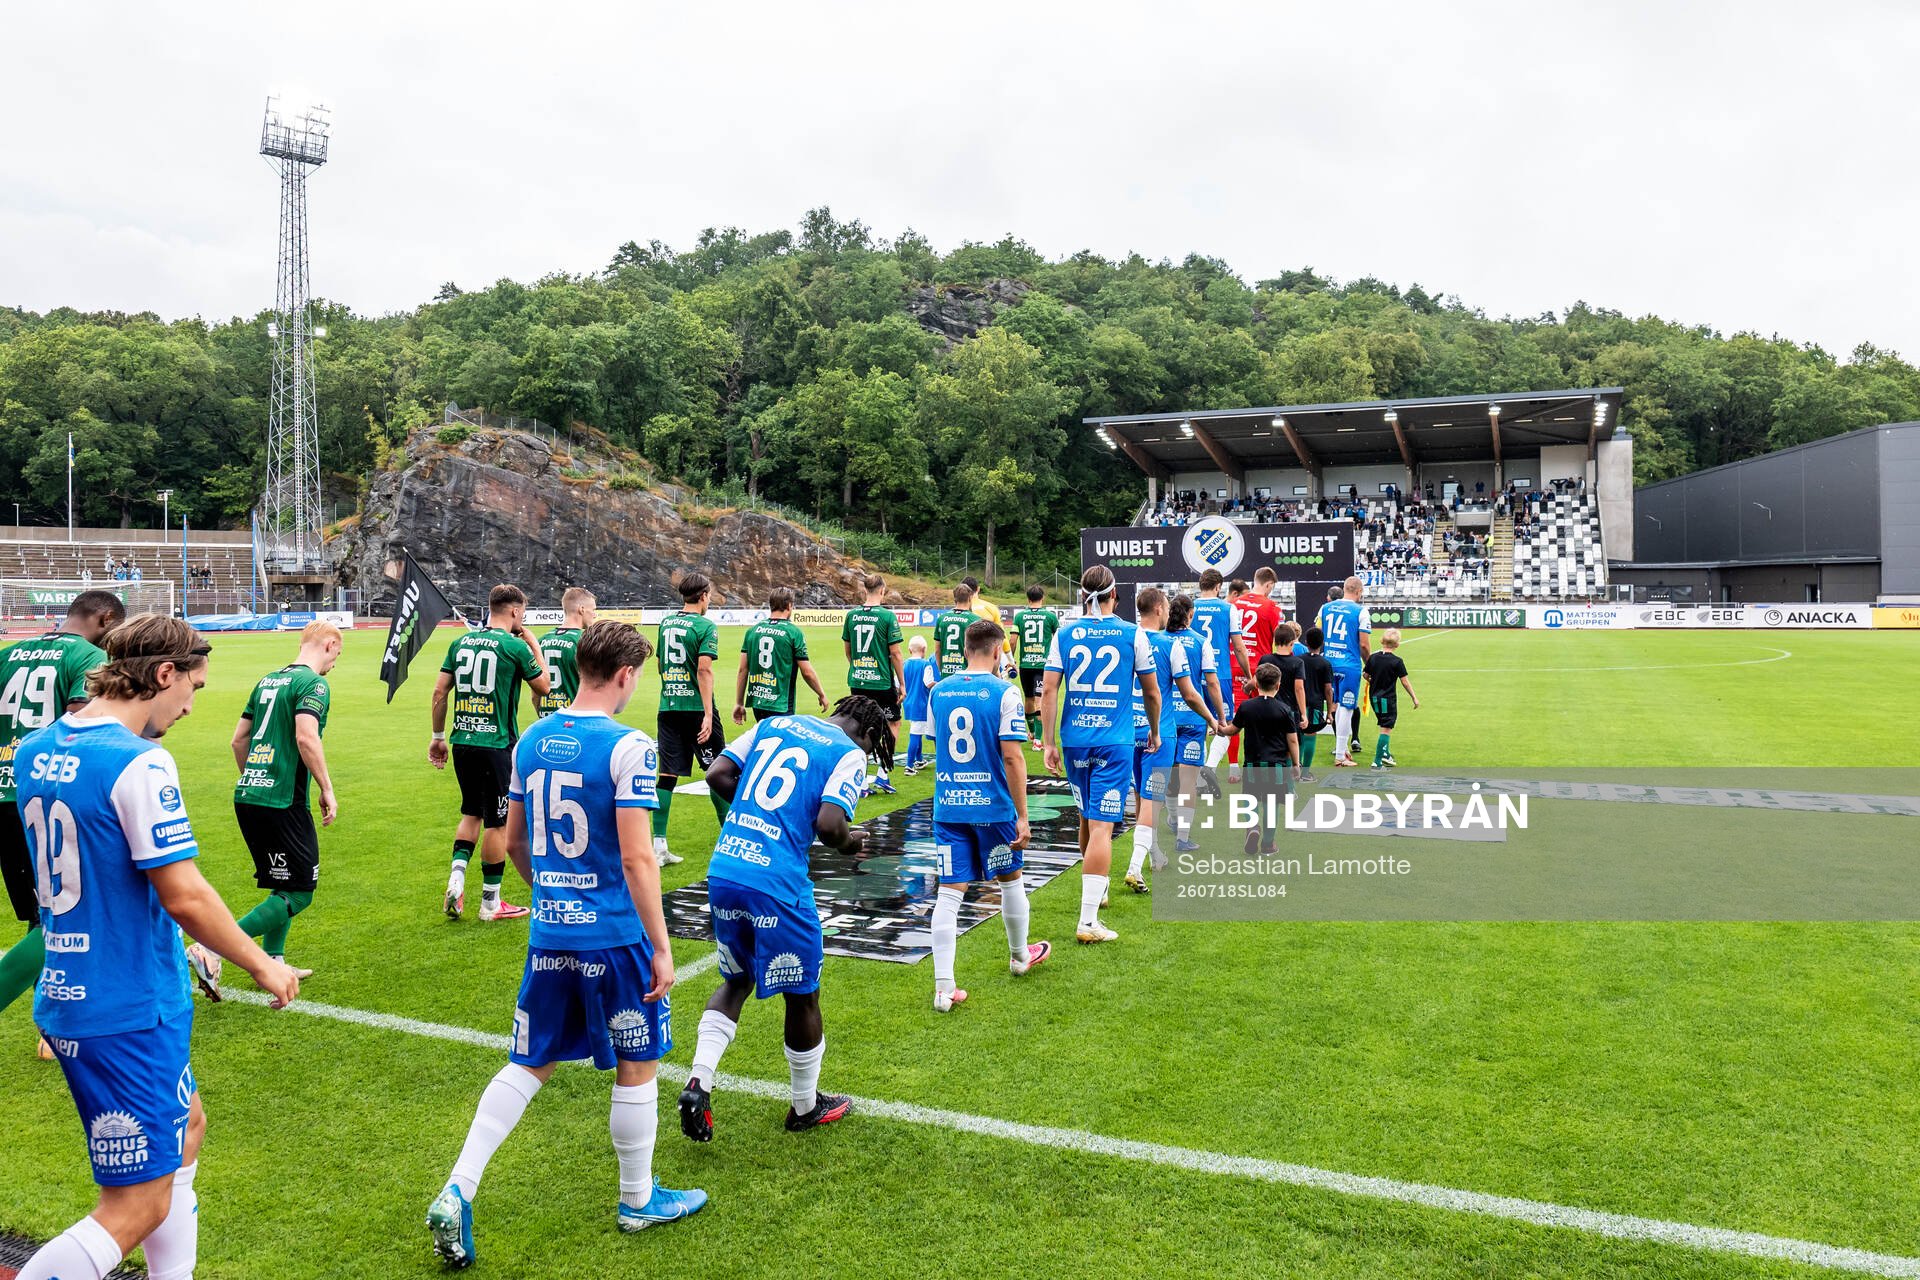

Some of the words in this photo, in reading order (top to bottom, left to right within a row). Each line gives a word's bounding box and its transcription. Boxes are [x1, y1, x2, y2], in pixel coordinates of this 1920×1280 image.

[1095, 539, 1167, 556] UNIBET
[1260, 535, 1338, 553] UNIBET
[794, 613, 843, 622] Ramudden
[852, 614, 879, 622] Derome
[1426, 609, 1499, 625] SUPERETTAN
[1654, 610, 1686, 621] EBC
[1712, 610, 1744, 621] EBC
[1787, 612, 1857, 624] ANACKA
[756, 626, 785, 637] Derome
[946, 624, 960, 650] 2
[1025, 620, 1044, 643] 21
[1088, 628, 1122, 636] Persson
[1198, 615, 1213, 641] 3
[1326, 613, 1348, 640] 14
[461, 636, 499, 648] Derome
[662, 628, 687, 664] 15
[854, 624, 875, 653] 17
[758, 636, 775, 669] 8
[455, 649, 497, 694] 20
[1069, 645, 1120, 693] 22
[0, 665, 57, 729] 49
[1086, 699, 1115, 707] KVANTUM
[253, 688, 279, 740] 7
[791, 722, 832, 746] Persson
[948, 707, 976, 763] 8
[30, 751, 80, 784] SEB
[742, 736, 809, 812] 16
[939, 797, 991, 806] WELLNESS
[526, 768, 589, 859] 15
[156, 821, 190, 838] UNIBE
[723, 834, 763, 853] NORDIC
[24, 796, 82, 916] 19
[268, 853, 287, 867] VS
[542, 874, 594, 885] KVANTUM
